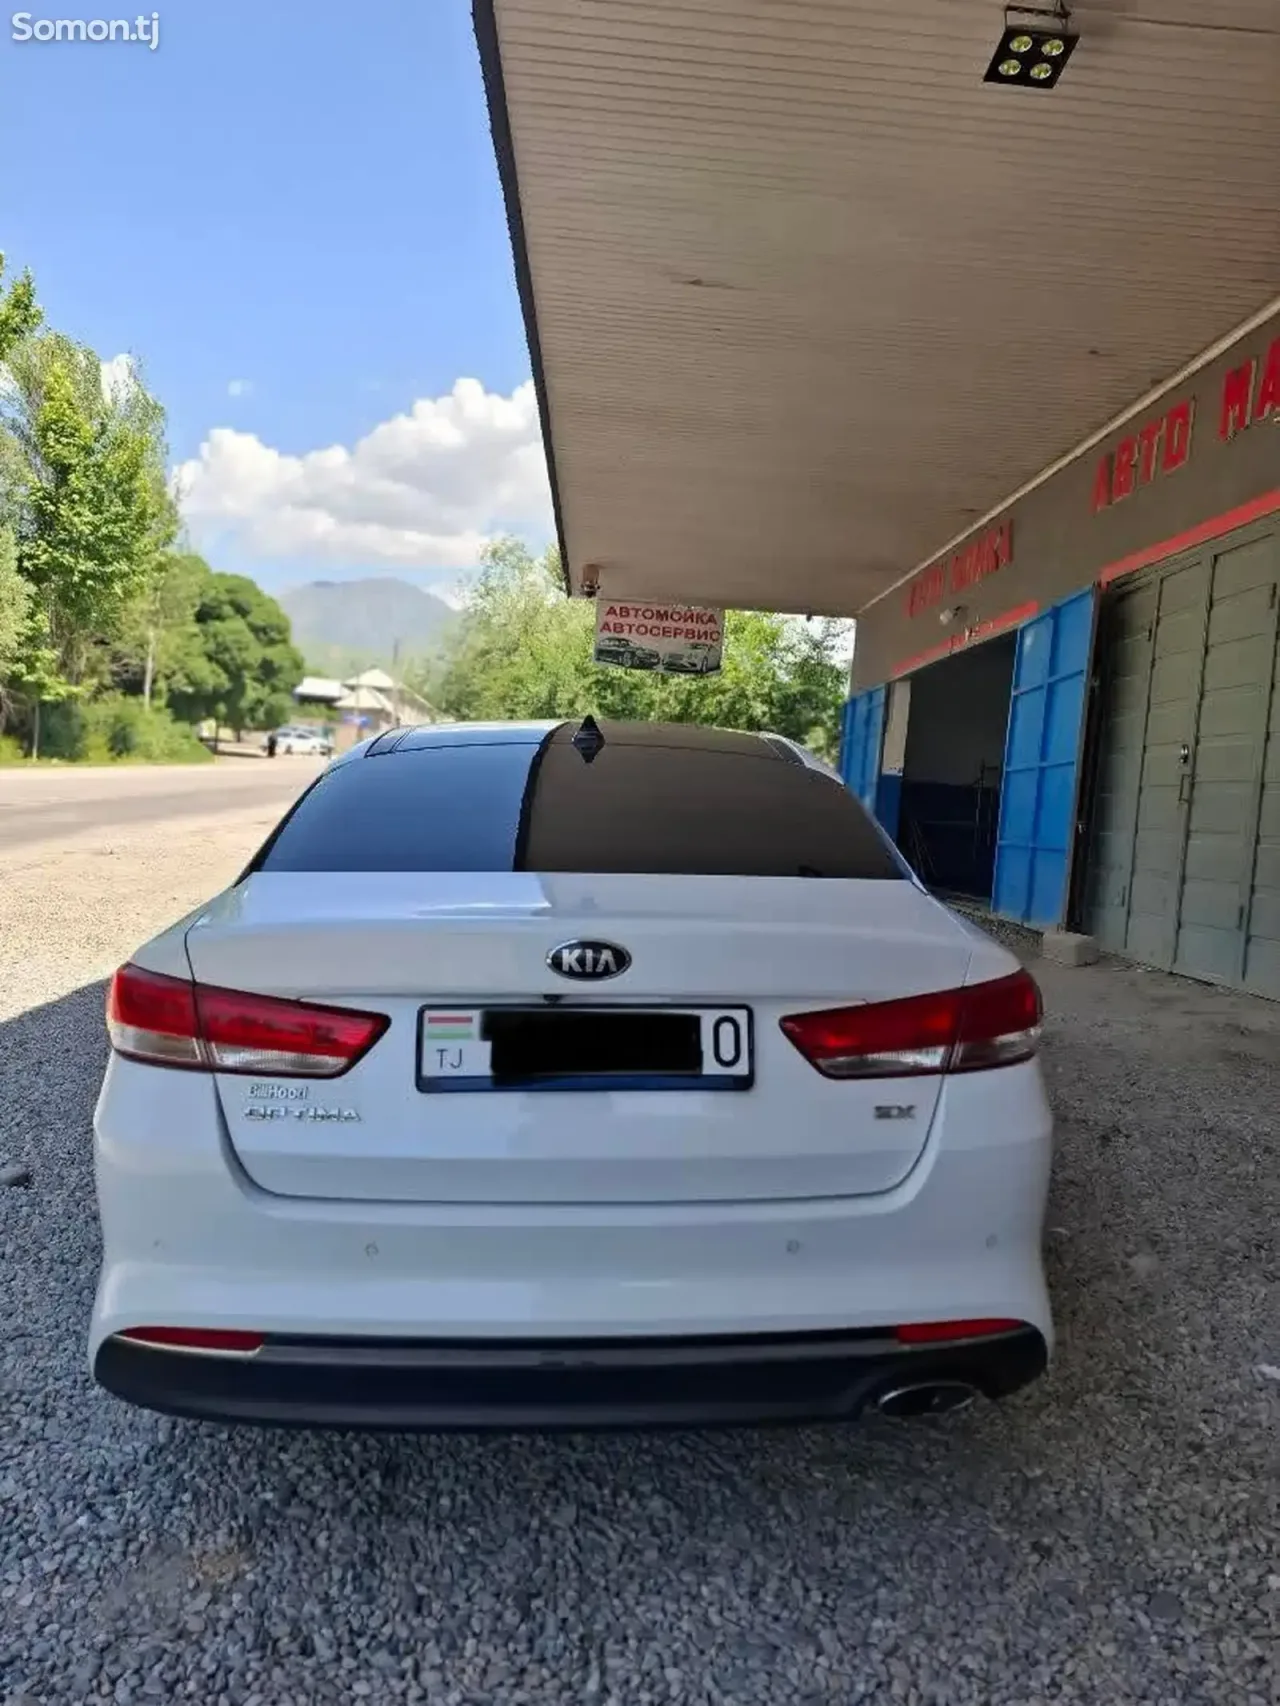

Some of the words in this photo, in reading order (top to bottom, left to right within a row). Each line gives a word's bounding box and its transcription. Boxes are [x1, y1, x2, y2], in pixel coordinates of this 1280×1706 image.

[605, 605, 718, 625] АВТОМОЙКА
[600, 621, 721, 642] АВТОСЕРВИС
[561, 948, 618, 973] KIA
[436, 1048, 463, 1069] TJ
